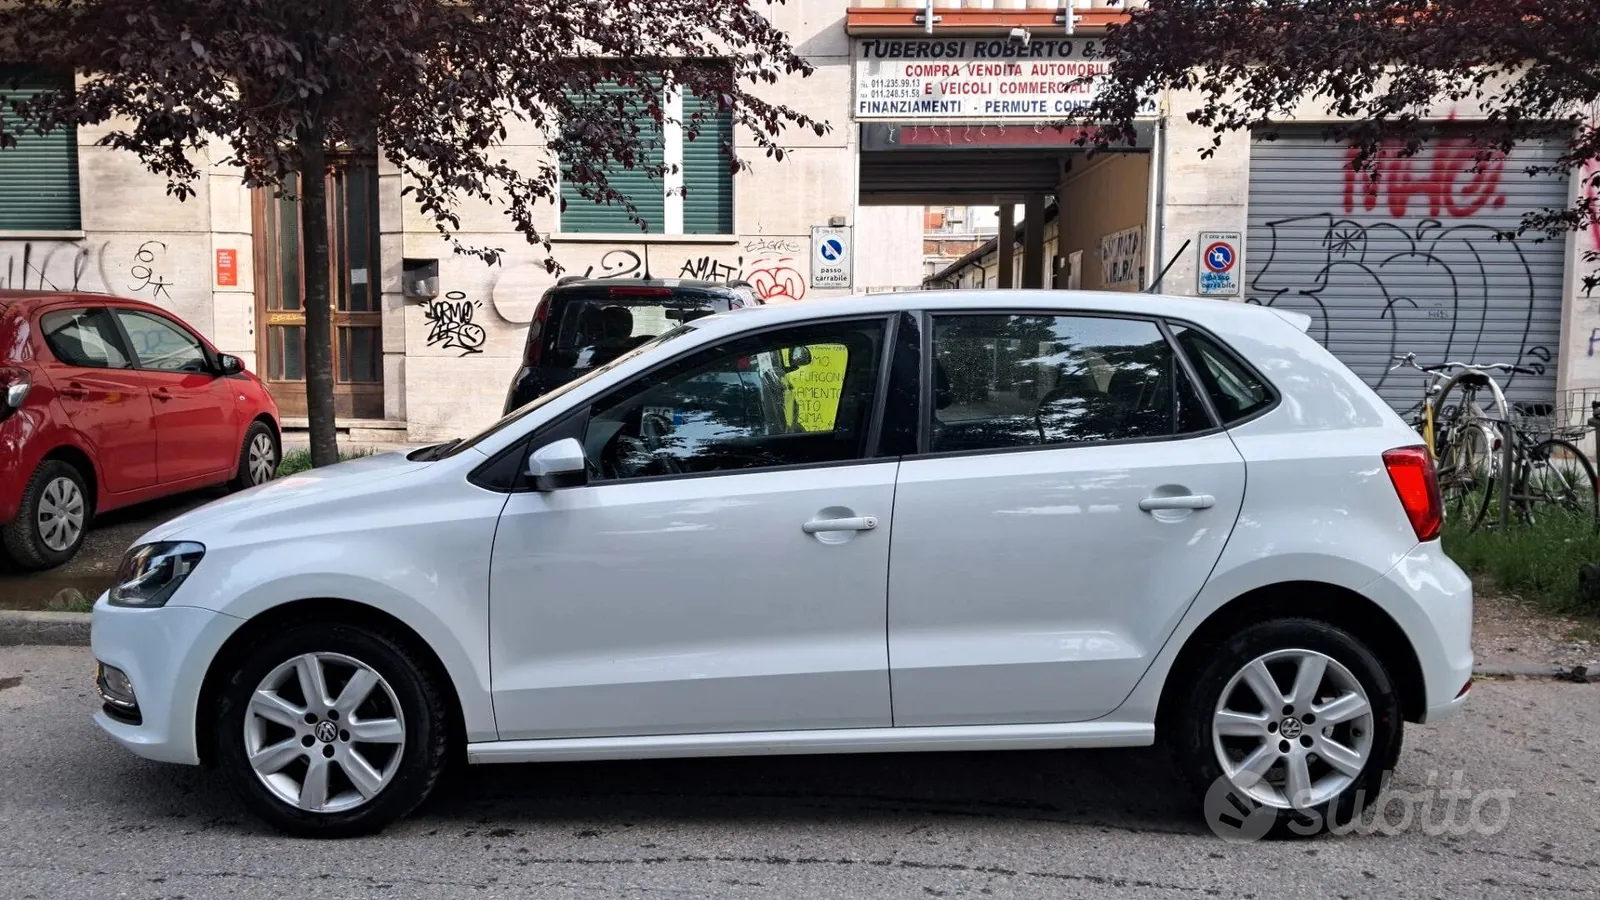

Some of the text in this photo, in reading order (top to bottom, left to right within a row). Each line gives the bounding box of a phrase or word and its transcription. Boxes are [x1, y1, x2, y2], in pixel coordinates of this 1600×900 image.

[862, 41, 966, 58] TUBEROSI
[973, 41, 1073, 58] ROBERTO
[905, 64, 960, 77] COMPRA
[968, 64, 1022, 76] VENDITA
[871, 79, 920, 88] 011.235.99.13
[925, 83, 933, 95] E
[940, 82, 992, 95] VEICOLI
[860, 101, 961, 113] FINANZIAMENTI
[985, 100, 1047, 113] PERMUTE
[799, 371, 842, 383] FURGON
